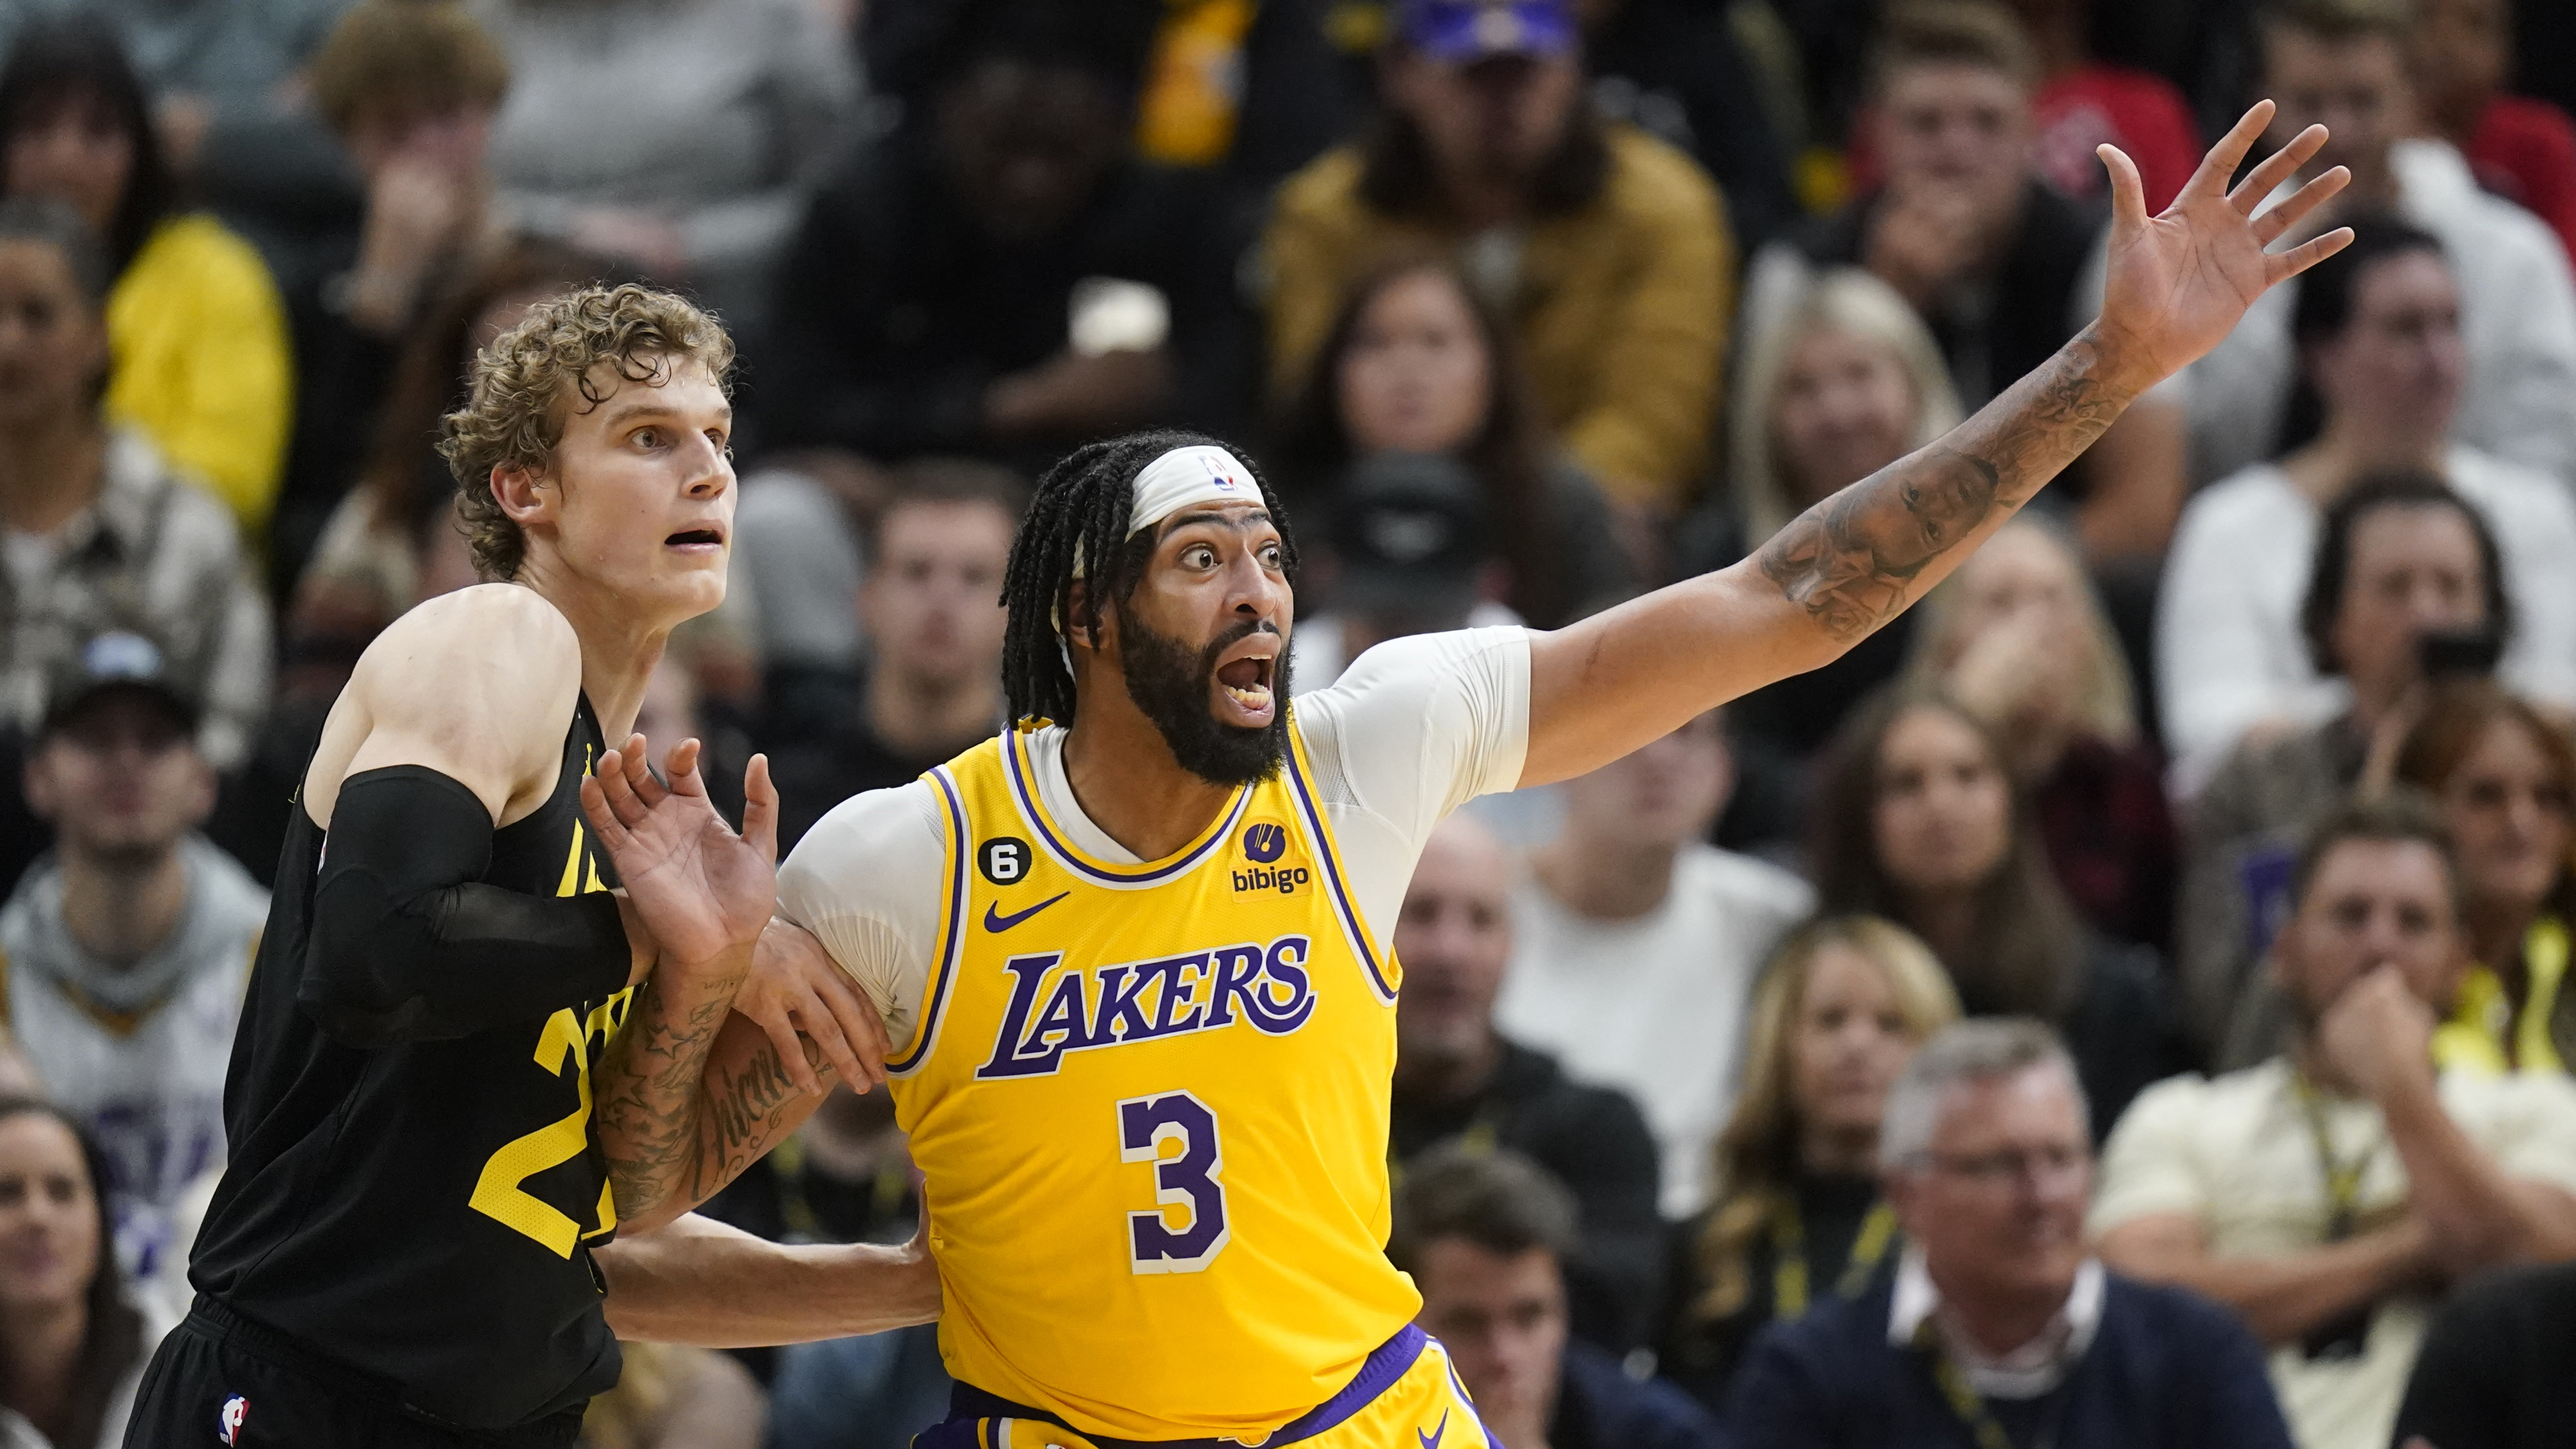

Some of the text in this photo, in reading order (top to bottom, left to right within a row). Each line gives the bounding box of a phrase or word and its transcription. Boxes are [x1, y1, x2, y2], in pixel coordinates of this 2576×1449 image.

[989, 843, 1019, 880] 6
[1232, 866, 1309, 894] bibigo
[973, 933, 1318, 1080] LAKERS
[1116, 1088, 1230, 1275] 3
